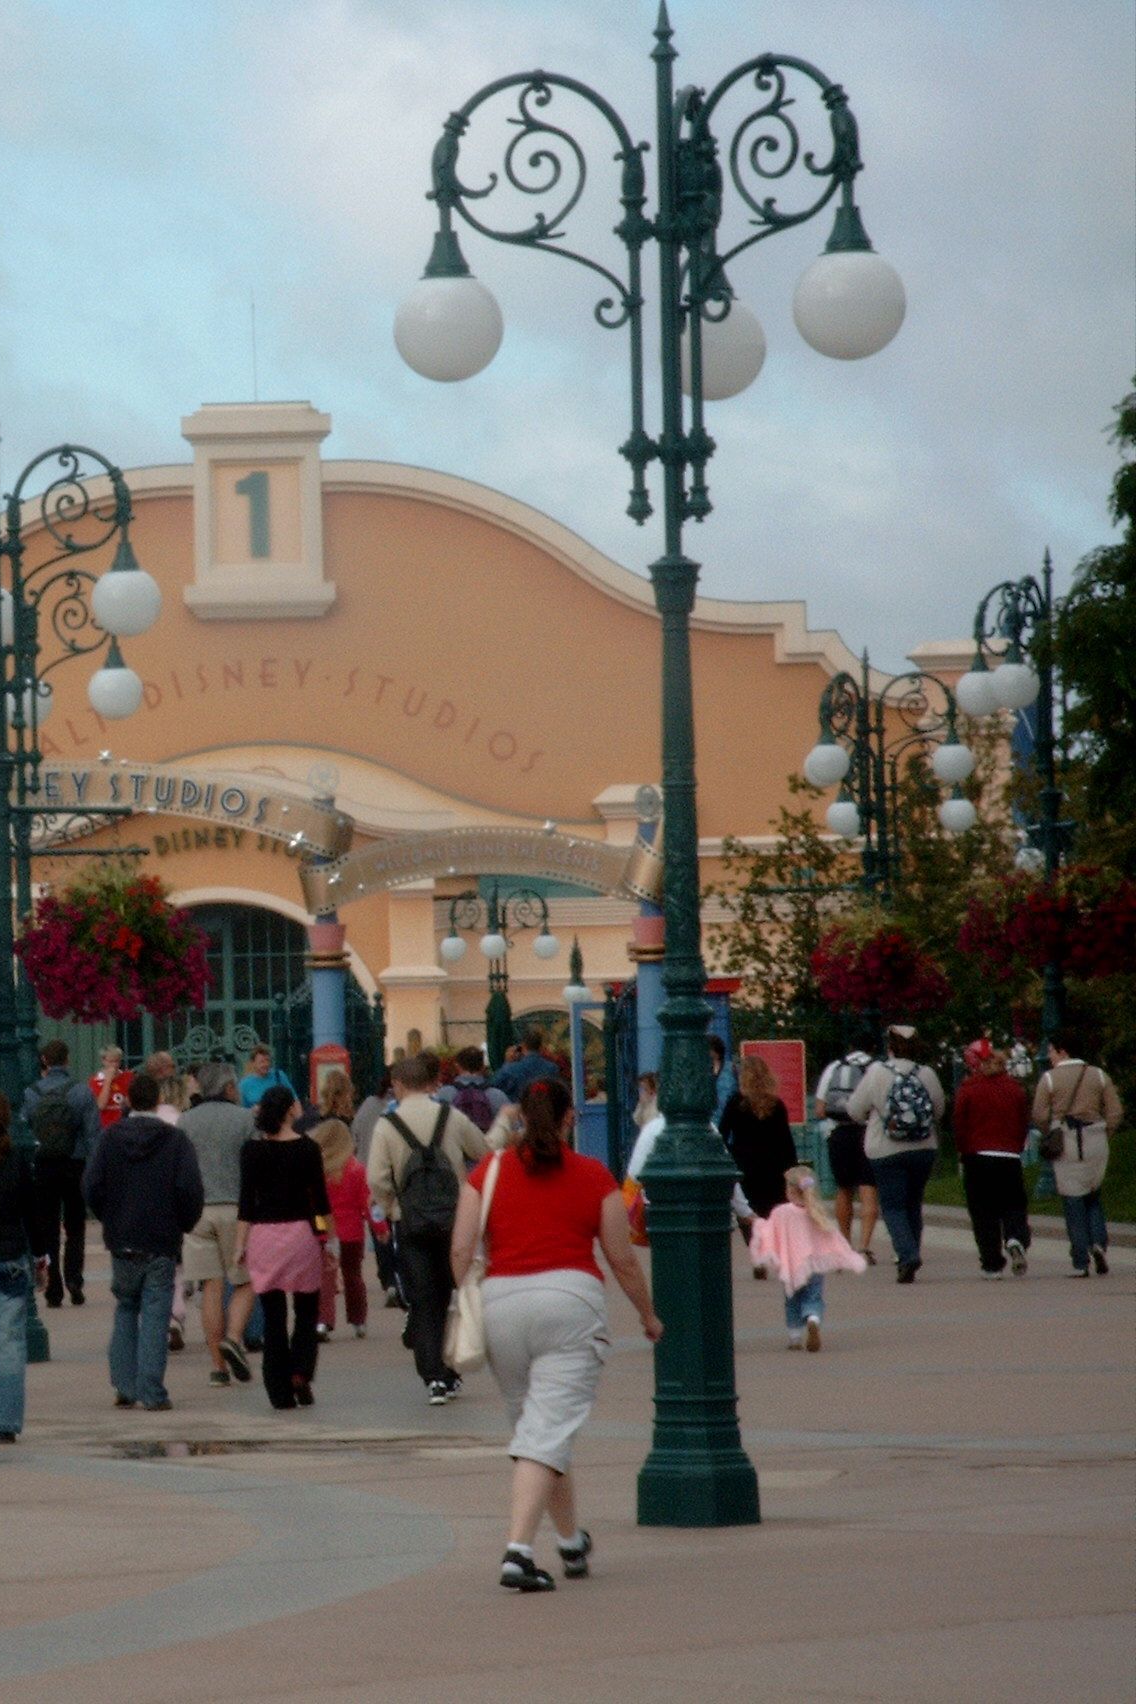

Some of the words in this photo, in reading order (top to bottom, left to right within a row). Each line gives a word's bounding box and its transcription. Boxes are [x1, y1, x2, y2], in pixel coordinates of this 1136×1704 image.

[235, 471, 270, 560] 1
[39, 707, 108, 755] ALT
[143, 657, 311, 710] DISNEY
[342, 667, 544, 774] STUDIOS
[109, 773, 270, 825] STUDIOS
[154, 826, 246, 858] DISNEY
